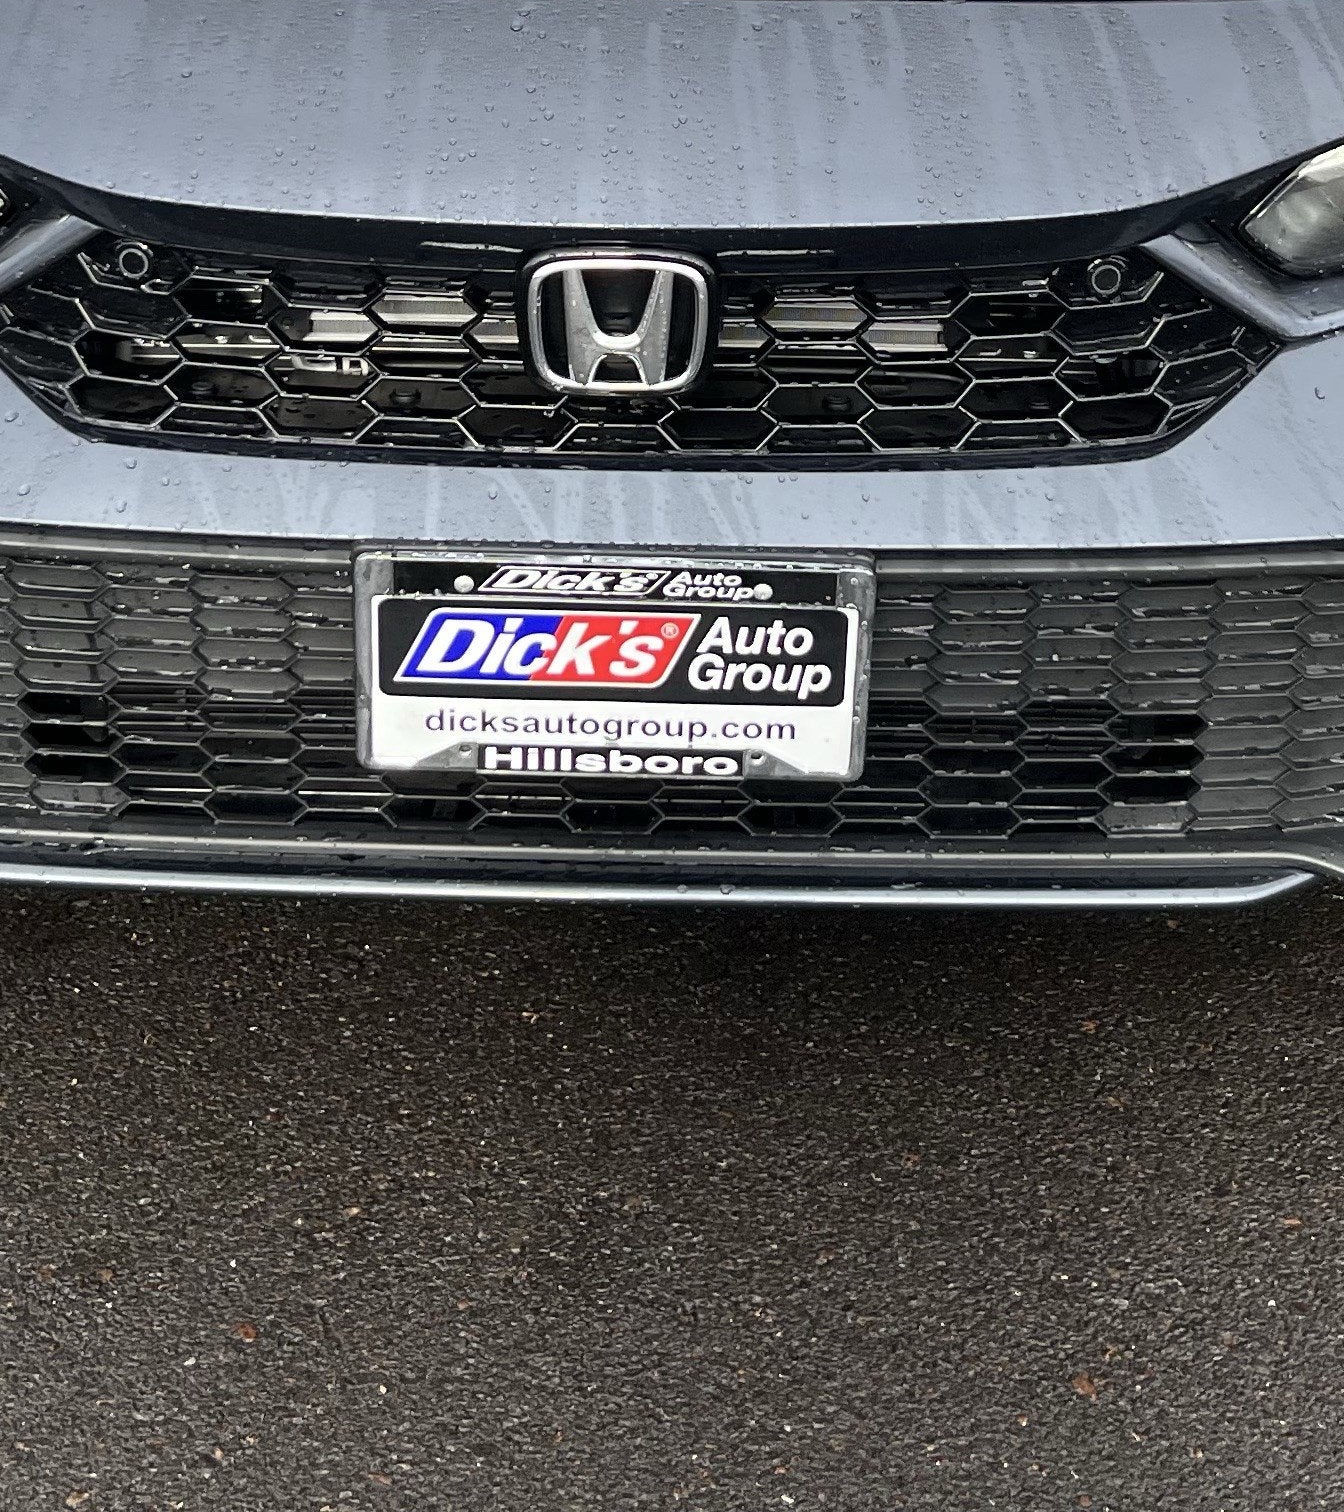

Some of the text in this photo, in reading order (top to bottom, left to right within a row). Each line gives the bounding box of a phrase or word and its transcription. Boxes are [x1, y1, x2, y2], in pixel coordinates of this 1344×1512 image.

[663, 584, 755, 601] Group
[670, 571, 743, 587] Auto
[416, 616, 662, 679] Dick's
[696, 616, 814, 656] Auto
[687, 653, 832, 700] Group
[425, 708, 797, 741] dicksautogroup.com
[484, 746, 739, 776] Hillsboro
